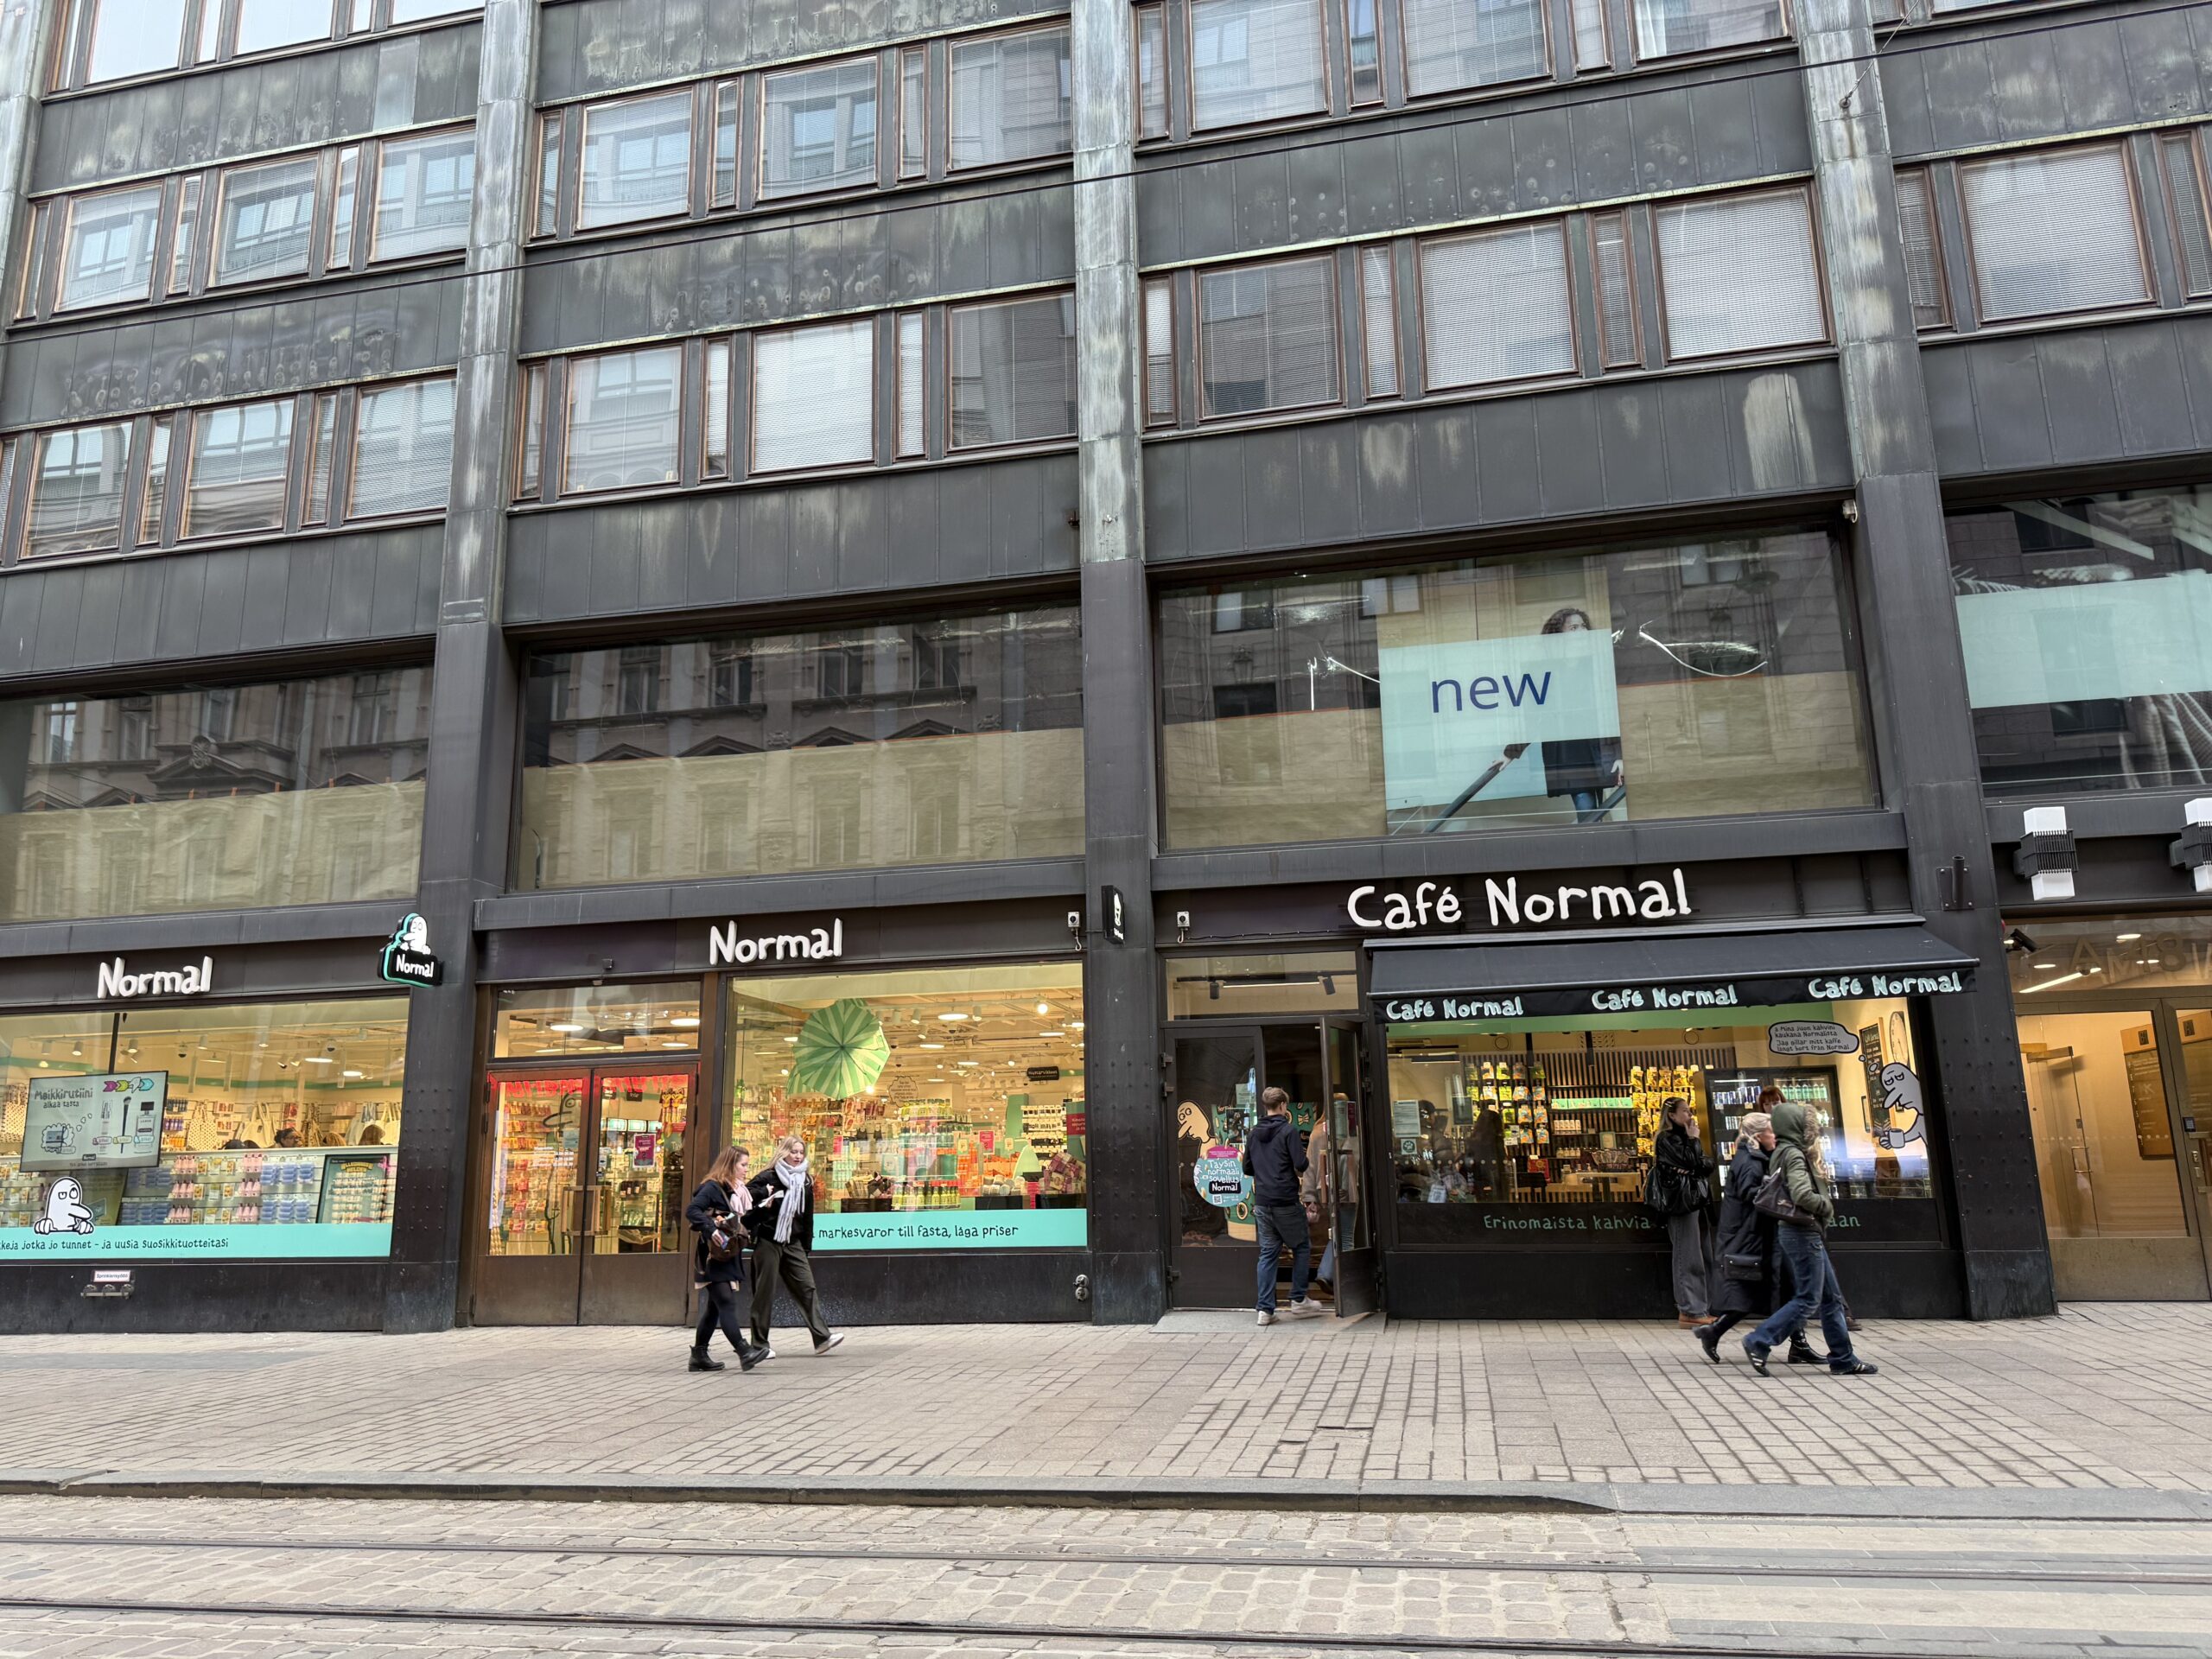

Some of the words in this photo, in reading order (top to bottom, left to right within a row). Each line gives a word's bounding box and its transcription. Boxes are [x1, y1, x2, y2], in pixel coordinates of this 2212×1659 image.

[1431, 671, 1552, 713] new
[1347, 881, 1462, 931] Café
[1484, 868, 1692, 927] Normal
[709, 918, 843, 965] Normal
[97, 955, 213, 1000] Normal
[396, 954, 434, 978] Normal
[1591, 988, 1644, 1011] Café
[1651, 983, 1738, 1008] Normal
[1808, 976, 1864, 999] Café
[1871, 971, 1962, 996] Normal
[1386, 999, 1435, 1020] Café
[1442, 995, 1523, 1020] Normal
[1211, 1183, 1238, 1192] Normal
[818, 1226, 894, 1239] markesvaror
[897, 1225, 914, 1238] till
[918, 1224, 951, 1239] fasta,
[982, 1224, 1020, 1239] priser
[1484, 1214, 1587, 1230] Erinomaista
[1593, 1213, 1651, 1230] kahvia
[0, 1239, 19, 1250] keja
[22, 1239, 46, 1250] jotka
[48, 1239, 58, 1250] jo
[61, 1240, 92, 1250] tunnet
[101, 1238, 111, 1250] ja
[114, 1239, 139, 1249] uusia
[142, 1237, 229, 1249] suosikkituotteitasi
